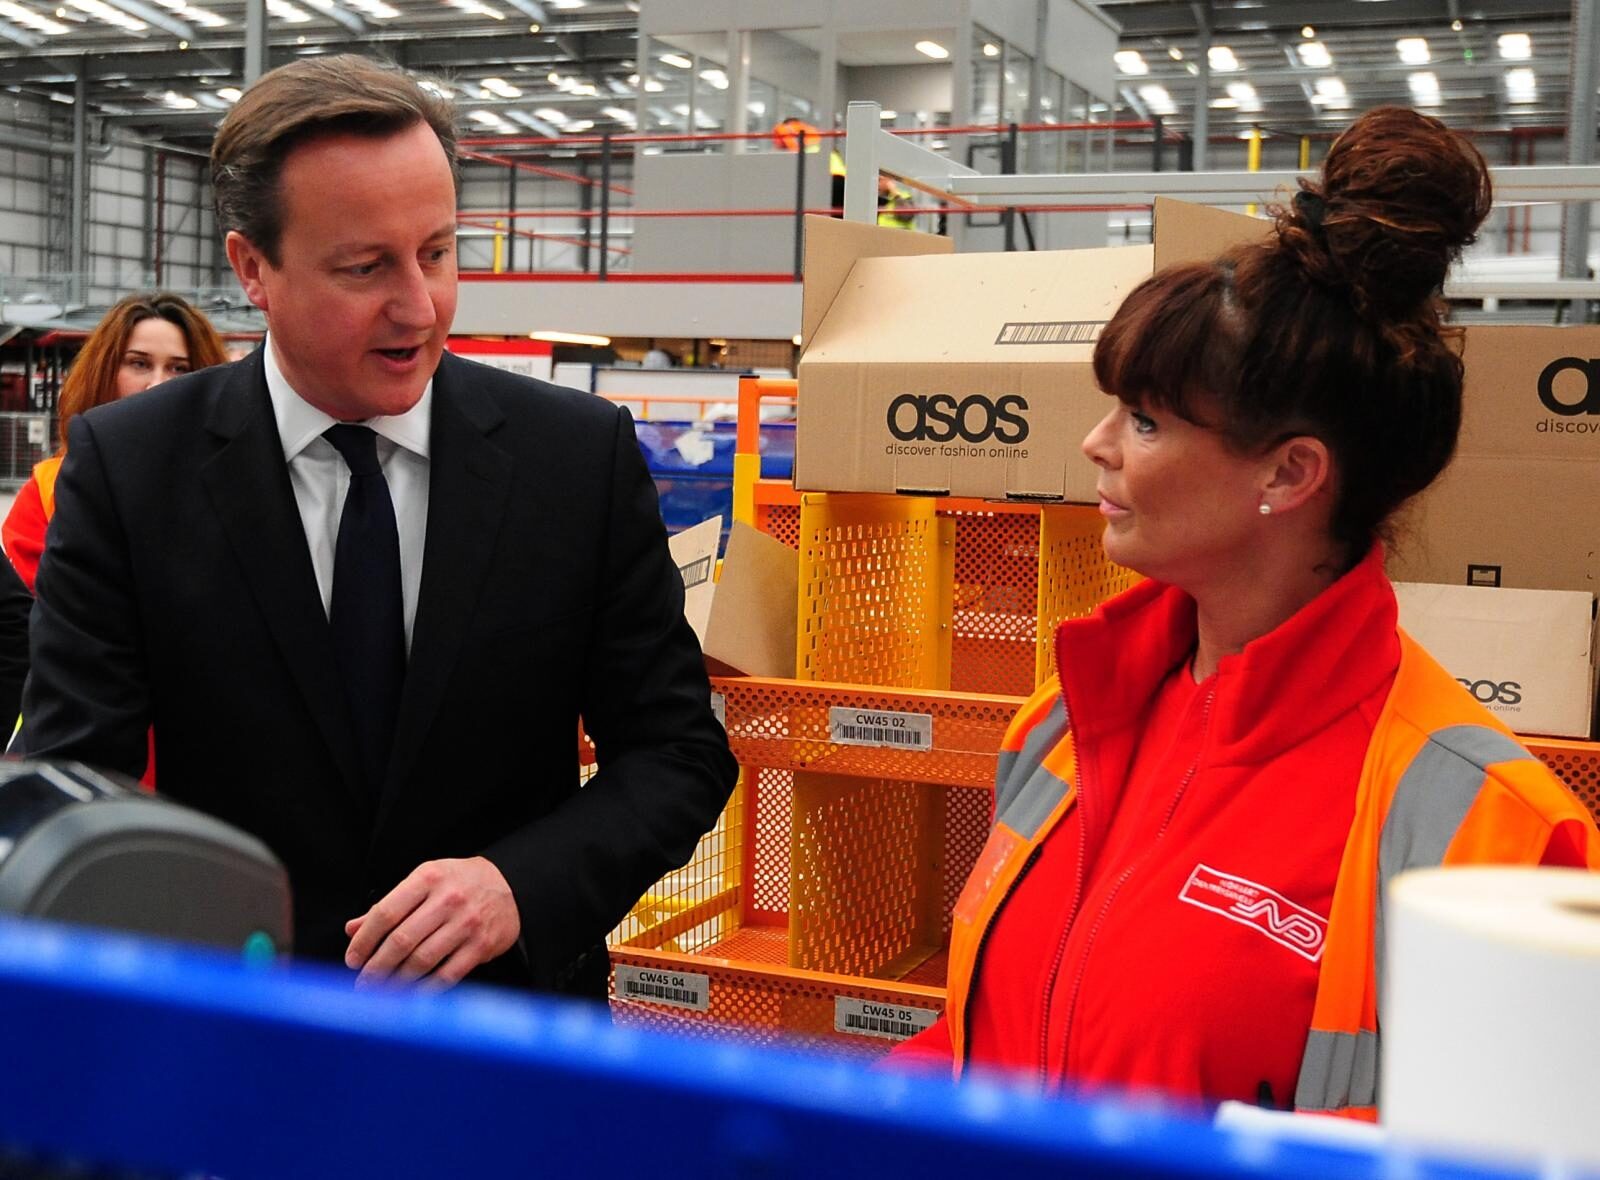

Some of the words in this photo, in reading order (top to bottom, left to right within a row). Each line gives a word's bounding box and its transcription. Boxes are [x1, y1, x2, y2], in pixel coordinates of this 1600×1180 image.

[887, 394, 1029, 444] asos
[1536, 418, 1600, 434] discov
[885, 444, 936, 456] discover
[940, 445, 986, 458] fashion
[989, 446, 1029, 459] online
[856, 714, 888, 727] CW45
[892, 717, 906, 728] 02
[639, 971, 669, 985] CW45
[671, 976, 685, 987] 04
[862, 1004, 895, 1018] CW45
[898, 1010, 912, 1021] 05
